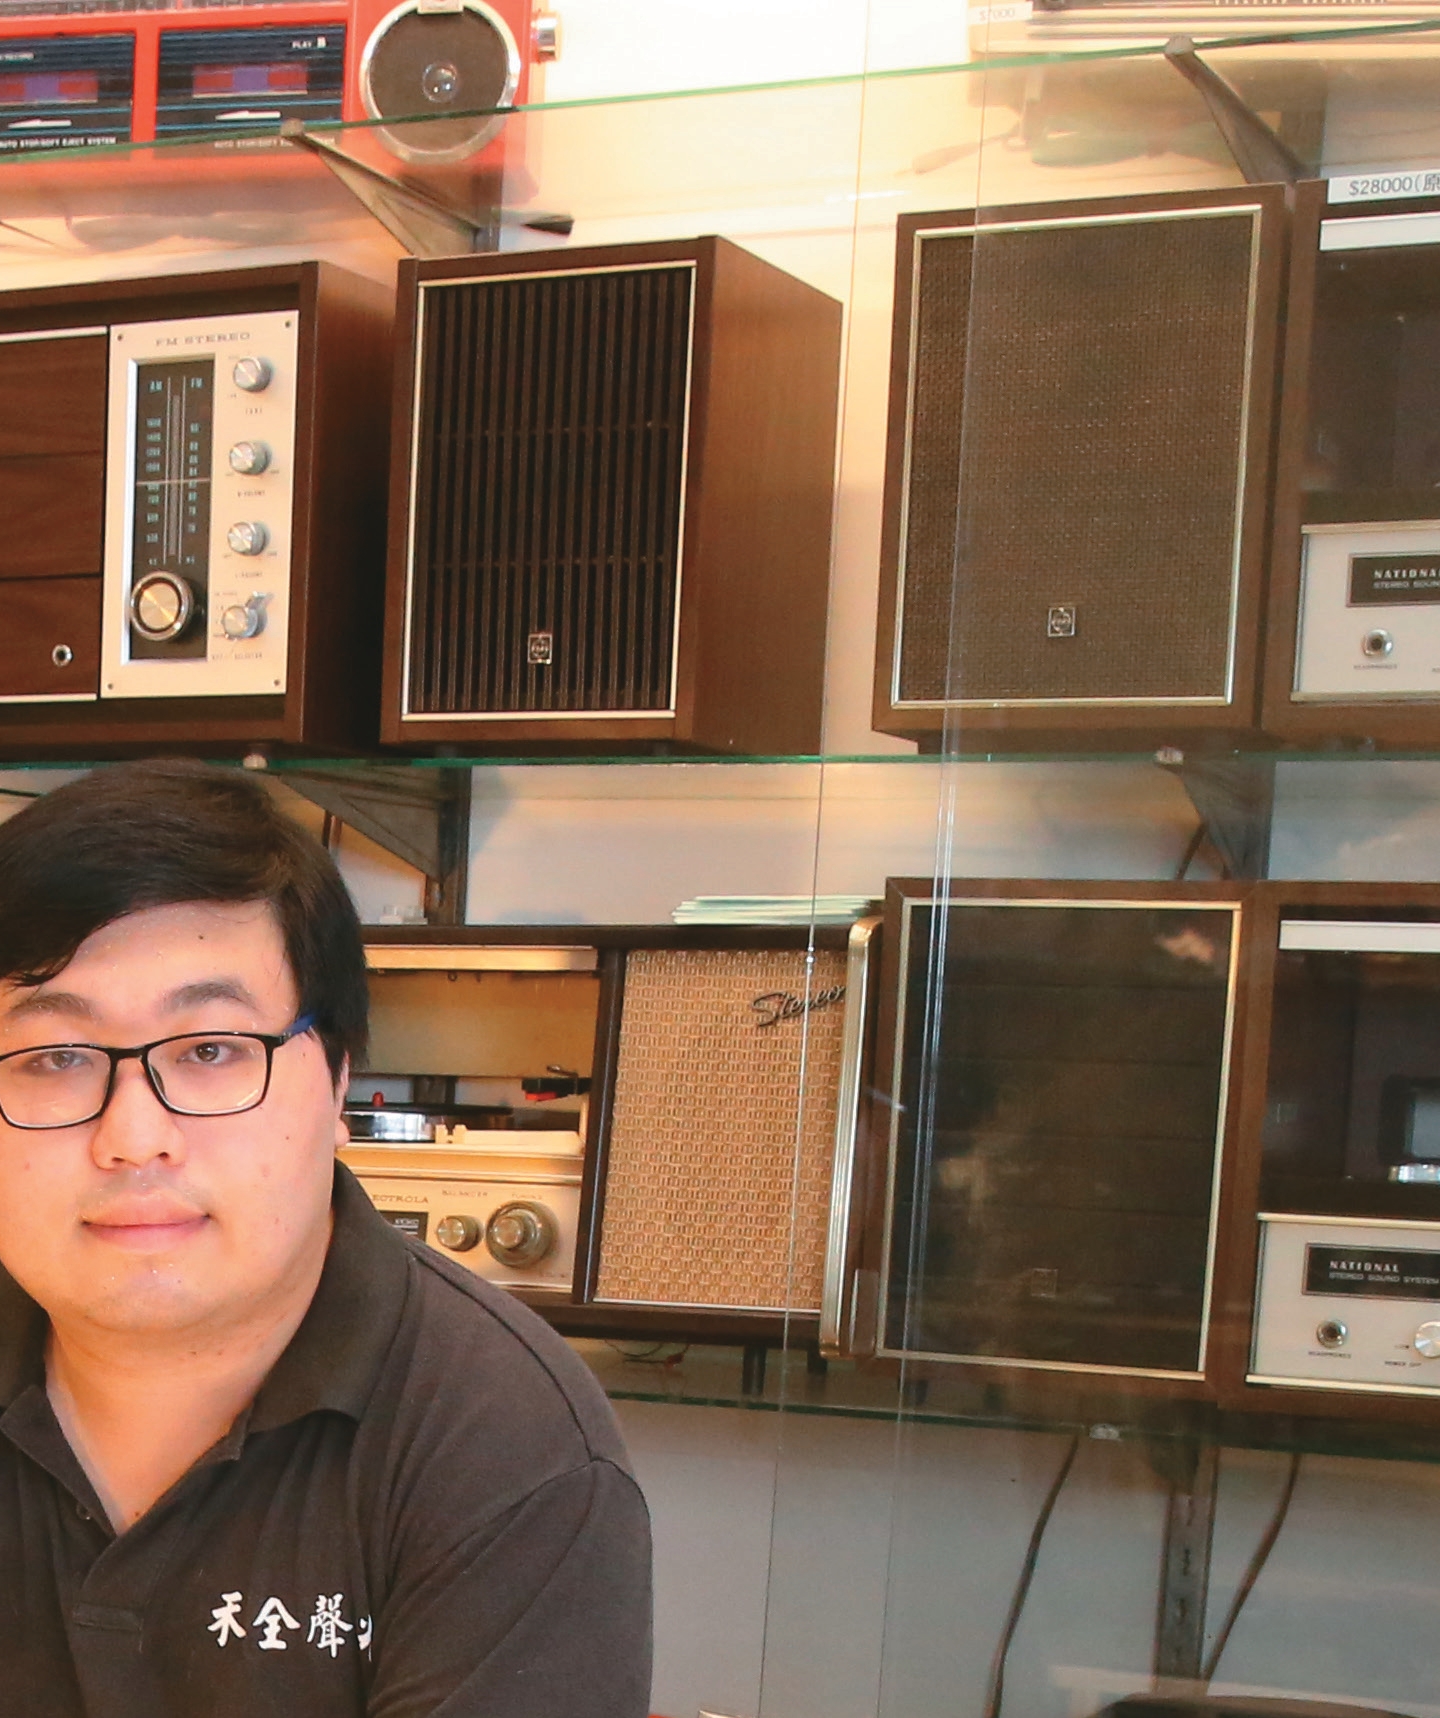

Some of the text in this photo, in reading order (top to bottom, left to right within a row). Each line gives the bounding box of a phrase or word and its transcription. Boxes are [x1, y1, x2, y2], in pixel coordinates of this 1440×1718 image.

[292, 40, 312, 49] PLAY
[87, 136, 117, 145] SYSTEM
[156, 332, 250, 347] FM STEREO
[150, 378, 202, 391] AM FM
[1374, 580, 1409, 589] STEREO
[751, 985, 846, 1028] Stereo
[1330, 1261, 1400, 1273] NATIONAL
[1329, 1273, 1439, 1284] STEREO SOUND SYSTEM
